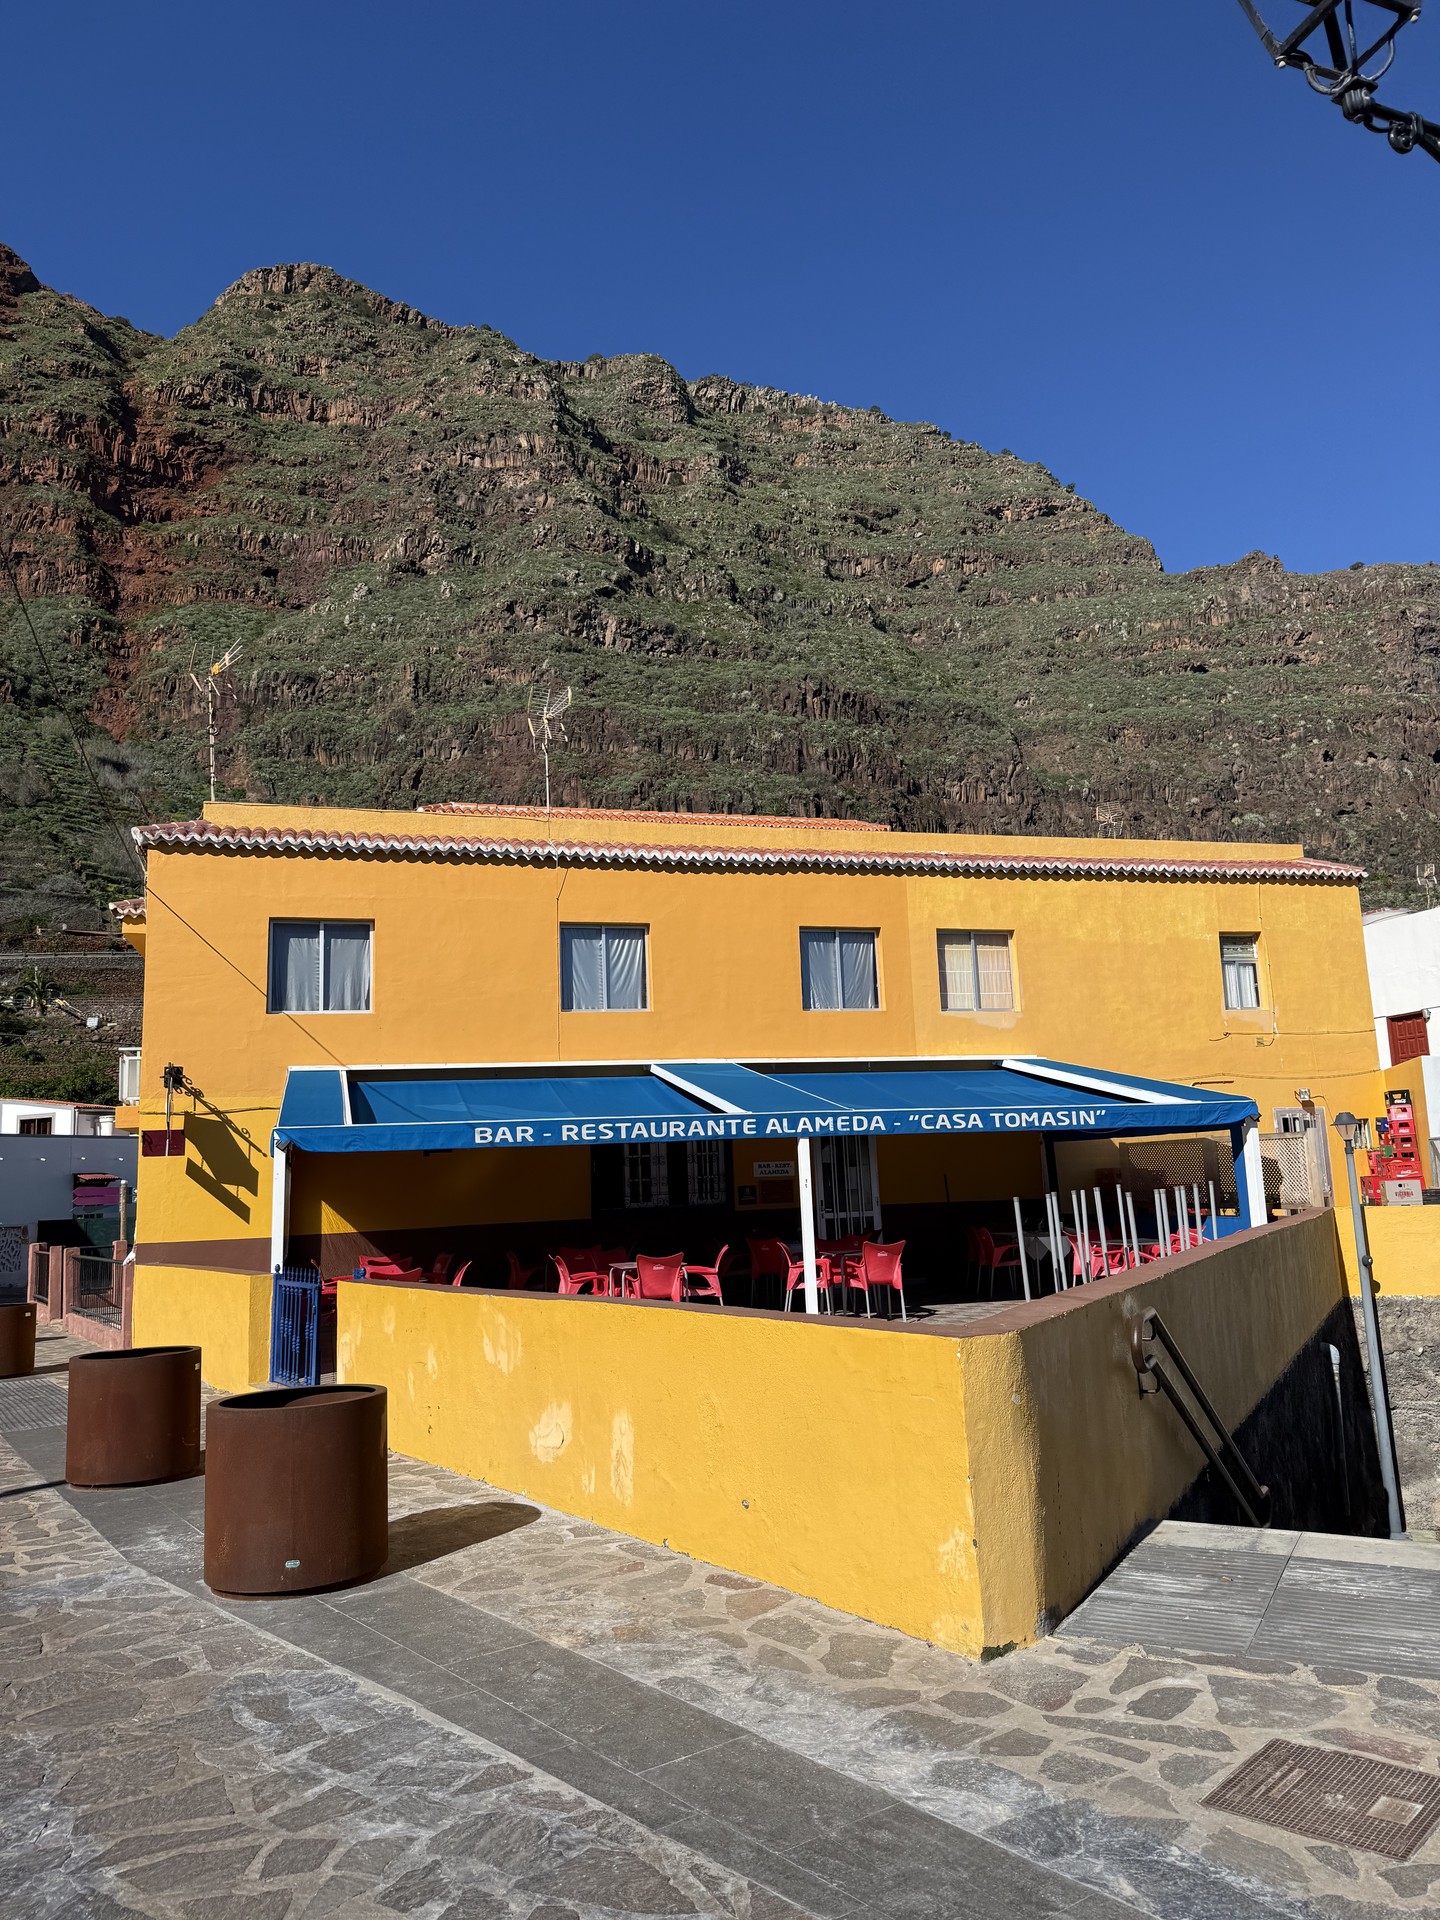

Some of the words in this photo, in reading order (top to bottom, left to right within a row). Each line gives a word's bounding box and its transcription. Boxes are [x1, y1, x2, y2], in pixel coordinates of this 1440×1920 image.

[474, 1126, 534, 1144] BAR
[561, 1118, 757, 1141] RESTAURANTE
[765, 1115, 886, 1134] ALAMEDA
